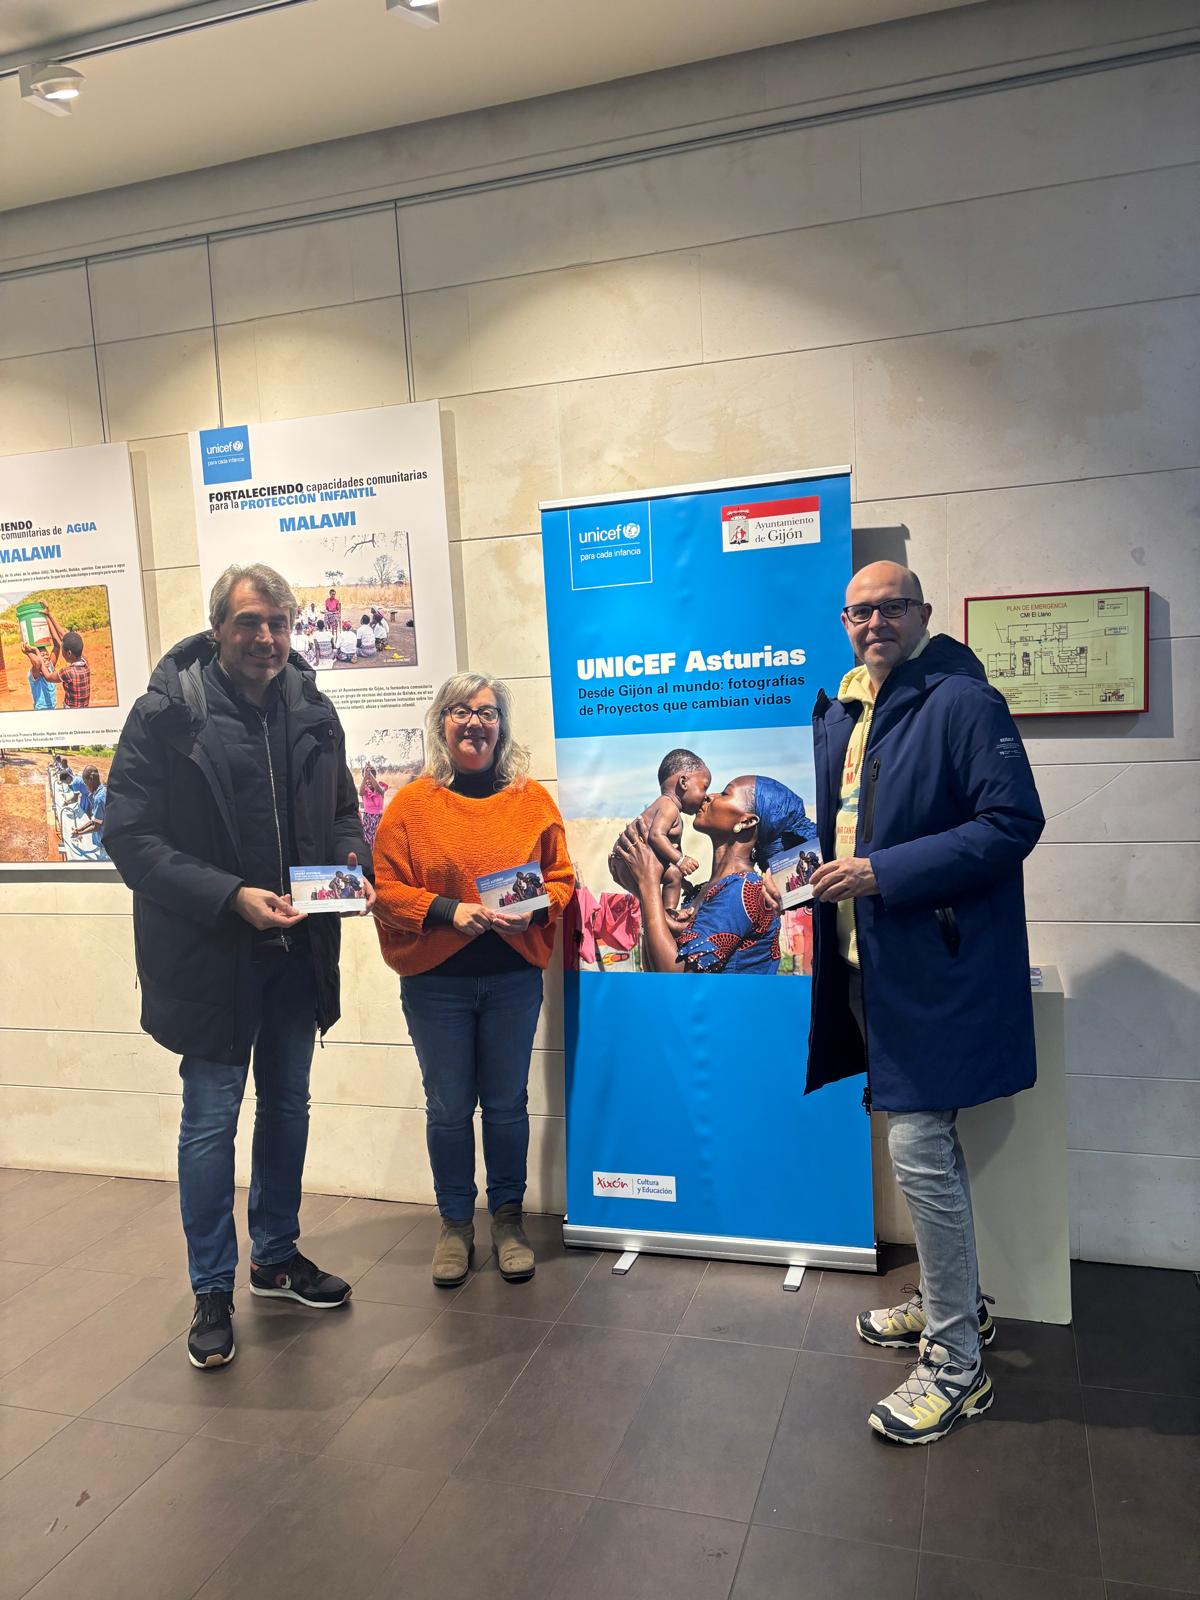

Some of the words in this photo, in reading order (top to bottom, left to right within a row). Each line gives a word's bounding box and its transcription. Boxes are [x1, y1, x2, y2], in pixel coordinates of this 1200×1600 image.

[206, 441, 233, 455] unicef
[209, 483, 304, 502] FORTALECIENDO
[306, 477, 364, 493] capacidades
[366, 470, 428, 486] comunitarias
[210, 503, 228, 514] para
[230, 500, 239, 509] la
[240, 492, 316, 510] PROTECCIÓN
[320, 486, 376, 502] INFANTIL
[0, 520, 32, 532] IENDO
[1, 528, 50, 540] comunitarias
[52, 526, 62, 536] de
[66, 522, 96, 534] AGUA
[280, 511, 356, 532] MALAWI
[755, 517, 814, 531] Ayuntamiento
[579, 524, 622, 544] unicef
[755, 534, 766, 543] de
[768, 528, 803, 546] Gijón
[0, 544, 62, 564] MALAWI
[580, 552, 596, 564] para
[596, 550, 612, 559] cada
[614, 546, 640, 557] infancia
[1030, 602, 1067, 610] EMERGENCIA
[577, 652, 676, 680] UNICEF
[684, 645, 806, 672] Asturias
[578, 687, 614, 699] Desde
[618, 684, 652, 698] Gijón
[658, 682, 668, 694] al
[672, 680, 724, 692] mundo:
[728, 674, 805, 690] fotografías
[580, 705, 594, 716] de
[598, 702, 658, 716] Proyectos
[663, 700, 688, 713] que
[692, 696, 748, 710] cambian
[754, 694, 792, 706] vidas
[642, 1186, 672, 1194] Educación
